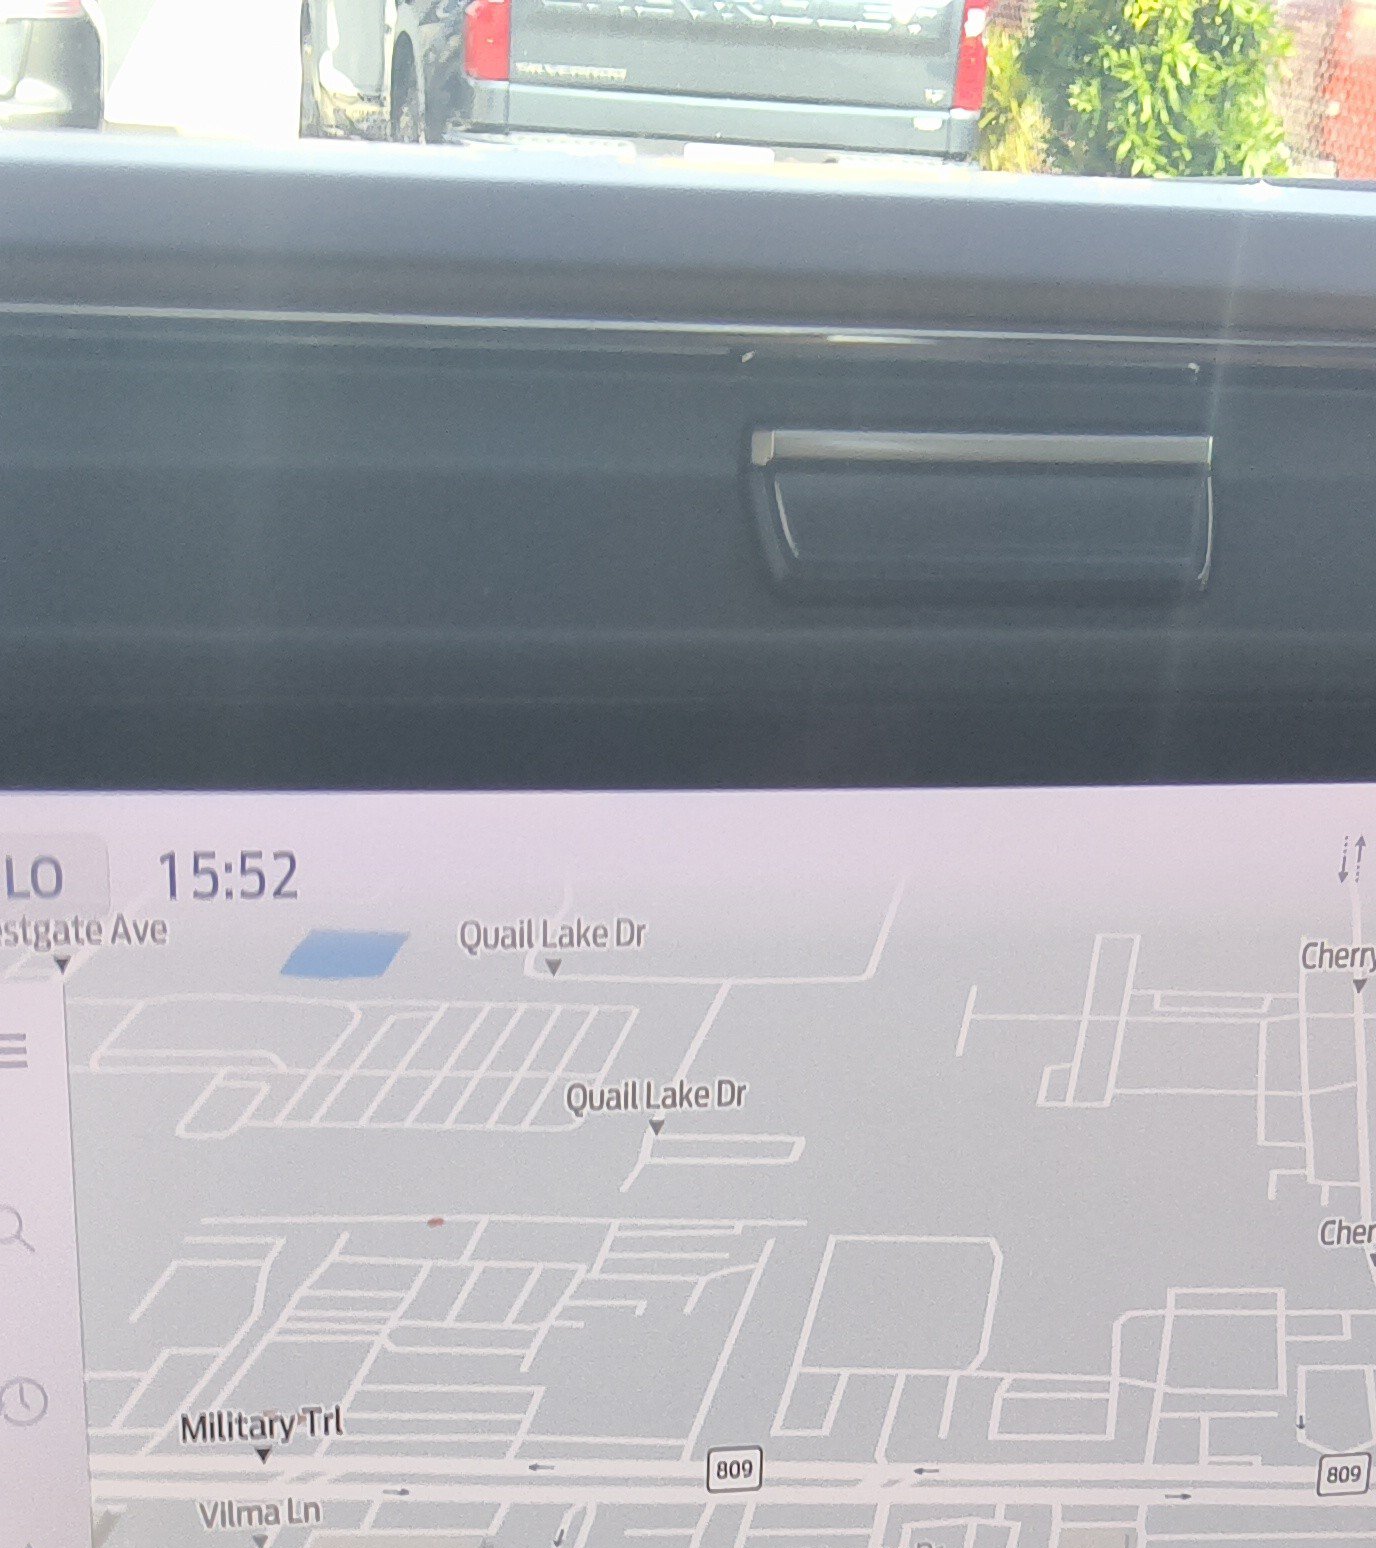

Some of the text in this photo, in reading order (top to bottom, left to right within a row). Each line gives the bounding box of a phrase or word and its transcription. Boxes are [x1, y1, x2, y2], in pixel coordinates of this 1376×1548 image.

[4, 854, 64, 899] LO
[159, 850, 299, 900] 15:52
[110, 913, 168, 945] Ave
[459, 918, 647, 954] Quail Lake Dr
[566, 1079, 747, 1117] Quail Lake Dr
[180, 1406, 345, 1446] Military Trl
[715, 1459, 754, 1480] 809
[1326, 1465, 1361, 1484] 809
[199, 1500, 321, 1529] Vilma Ln
